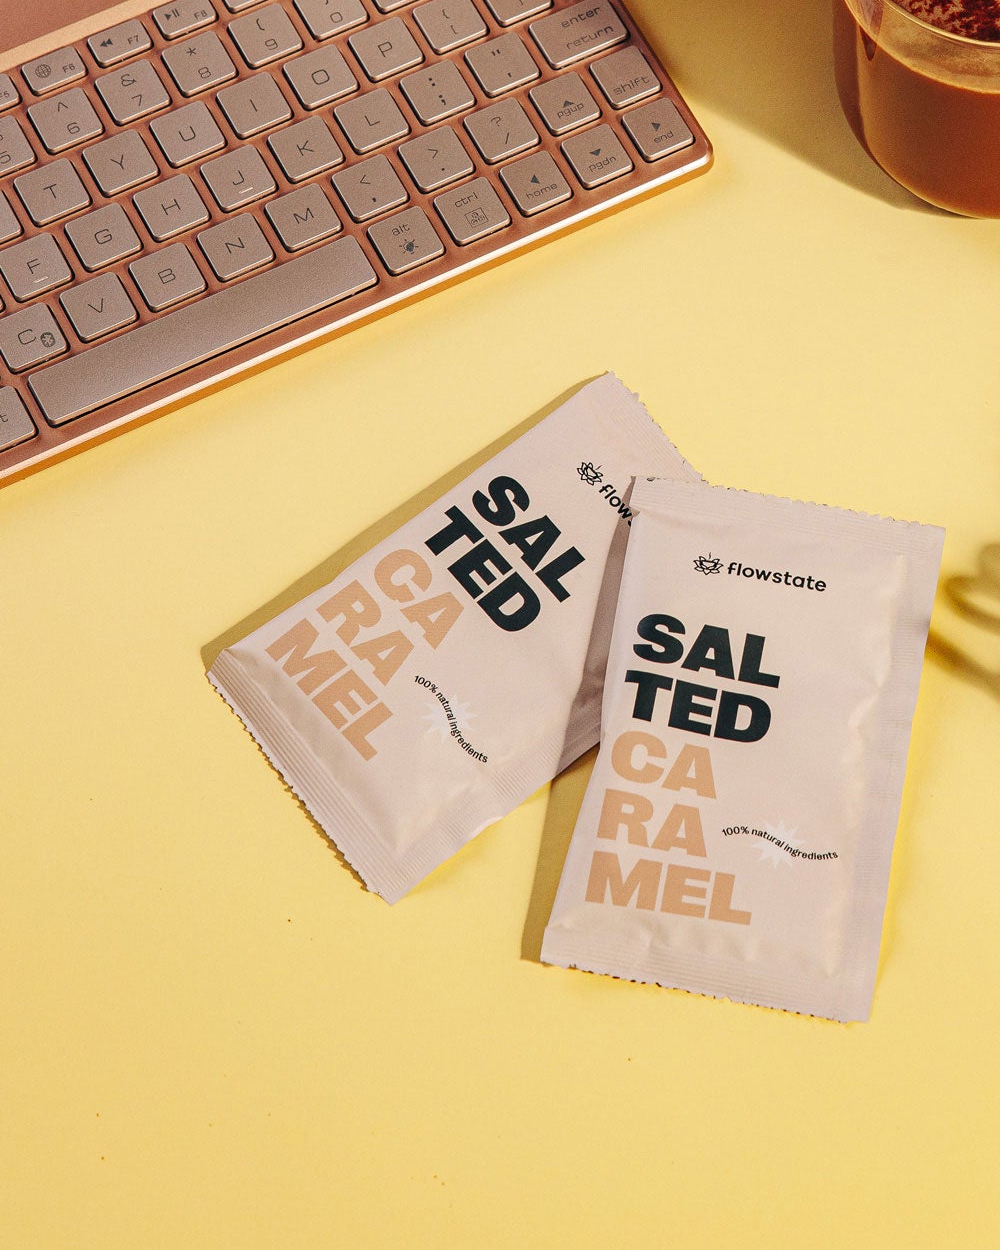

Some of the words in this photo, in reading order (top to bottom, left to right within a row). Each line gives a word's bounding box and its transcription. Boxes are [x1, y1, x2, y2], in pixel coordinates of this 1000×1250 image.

[193, 9, 209, 21] F8
[561, 6, 601, 29] enter
[127, 34, 140, 46] F7
[264, 38, 279, 50] 9
[565, 23, 614, 50] return
[377, 41, 393, 58] P
[62, 63, 76, 74] F6
[197, 66, 212, 79] 8
[120, 73, 137, 87] &
[612, 75, 650, 96] shift
[131, 94, 143, 107] 7
[556, 101, 585, 120] pgup
[66, 122, 81, 135] 6
[365, 113, 380, 127] L
[178, 125, 197, 142] U
[653, 129, 674, 144] end
[296, 139, 315, 157] K
[110, 154, 125, 170] Y
[587, 153, 617, 173] pgdn
[232, 169, 245, 186] J
[43, 183, 57, 199] T
[454, 191, 479, 208] ctrl
[525, 182, 558, 200] home
[161, 198, 181, 216] H
[292, 207, 315, 225] M
[94, 228, 113, 245] G
[391, 222, 411, 236] alt
[225, 236, 245, 255] N
[26, 258, 41, 275] F
[157, 267, 177, 285] B
[87, 297, 104, 314] V
[17, 328, 37, 346] C
[598, 484, 633, 527] flow
[472, 475, 586, 603] SAL
[424, 504, 541, 632] TED
[727, 561, 827, 592] flowstate
[373, 548, 465, 650] CA
[315, 579, 415, 686] RA
[632, 613, 781, 689] SAL
[264, 618, 394, 762] MEL
[624, 670, 772, 743] TED
[414, 675, 438, 694] 100%
[435, 692, 457, 721] natural
[449, 720, 488, 764] ingredients
[610, 730, 717, 800] CA
[596, 788, 708, 858] RA
[721, 825, 750, 837] 100%
[751, 828, 785, 848] natural
[783, 843, 839, 861] ingredients
[584, 850, 752, 926] MEL
